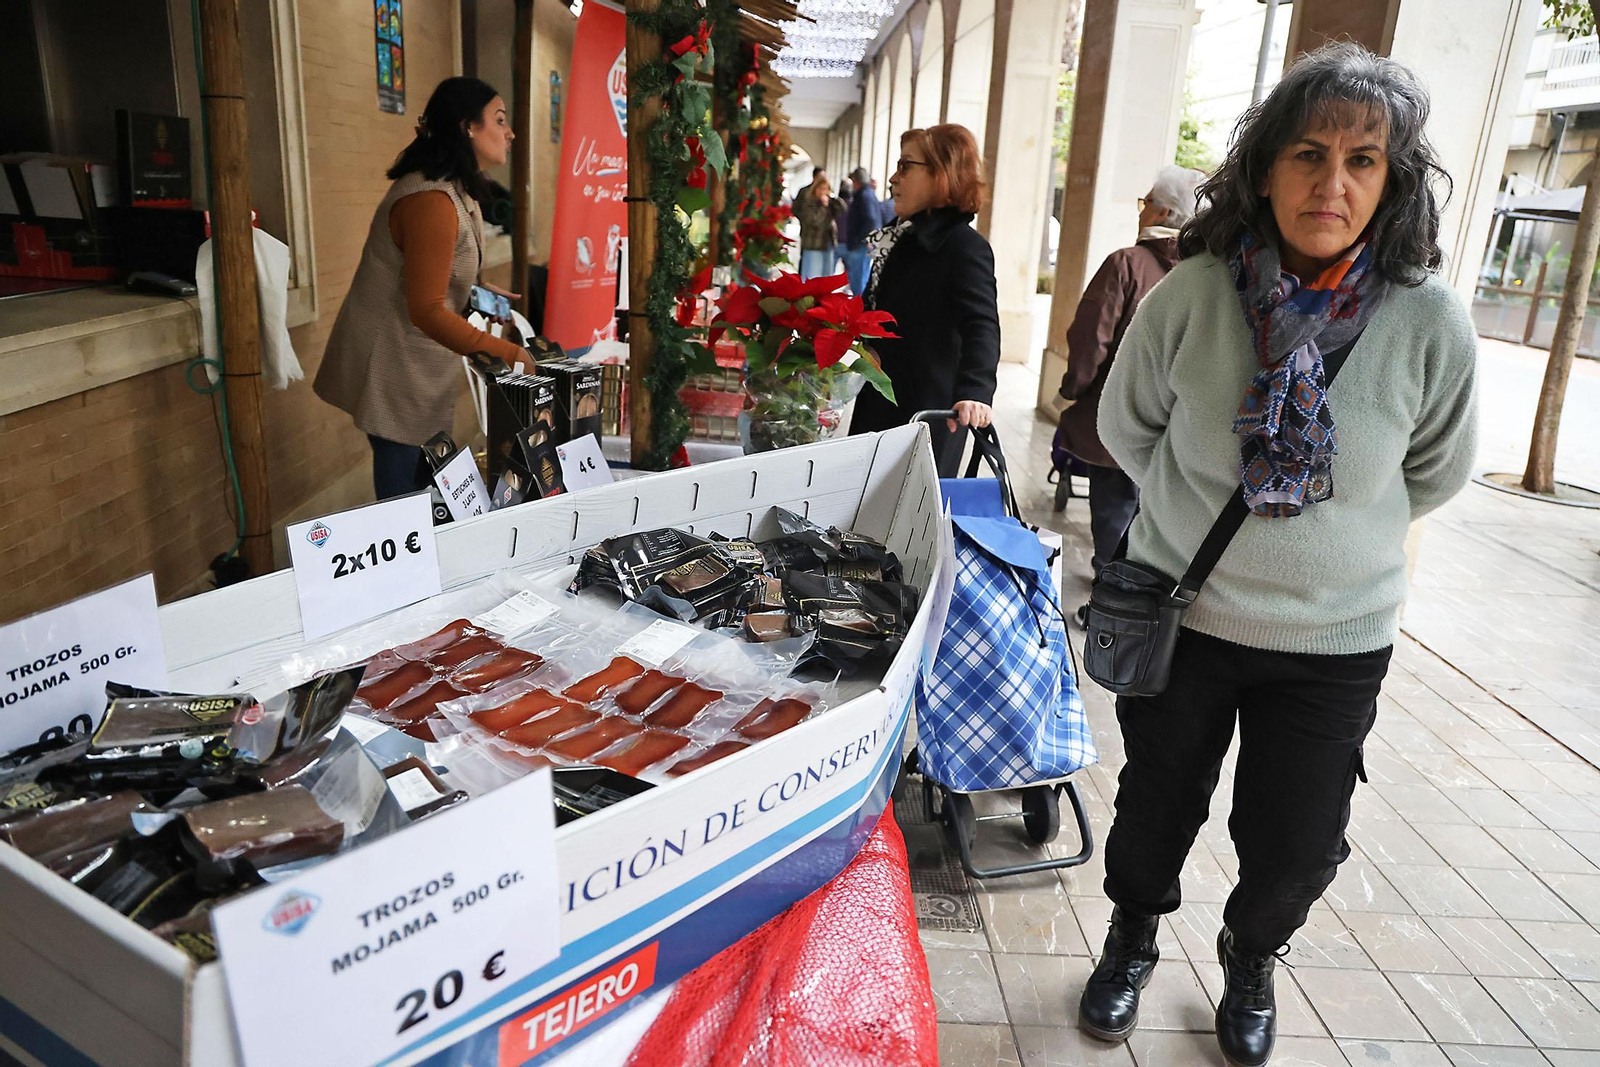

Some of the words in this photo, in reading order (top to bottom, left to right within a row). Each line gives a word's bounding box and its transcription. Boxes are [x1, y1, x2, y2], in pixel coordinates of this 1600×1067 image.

[579, 460, 588, 474] 4
[587, 456, 596, 470] €
[451, 479, 470, 501] ESTUCHES
[467, 472, 475, 484] DE
[462, 499, 467, 509] 3
[465, 490, 477, 507] LATAS
[310, 528, 328, 541] USISA
[331, 538, 397, 579] 2x10
[405, 531, 421, 554] €
[6, 644, 83, 682] TROZOS
[80, 654, 110, 674] 500
[115, 645, 137, 660] Gr.
[189, 699, 235, 712] USISA
[702, 798, 747, 846] DE
[357, 872, 456, 929] TROZOS
[331, 911, 439, 975] MOJAMA
[452, 884, 490, 914] 500
[497, 869, 525, 890] Gr.
[394, 969, 464, 1036] 20
[482, 950, 506, 982] €
[522, 962, 640, 1051] TEJERO
